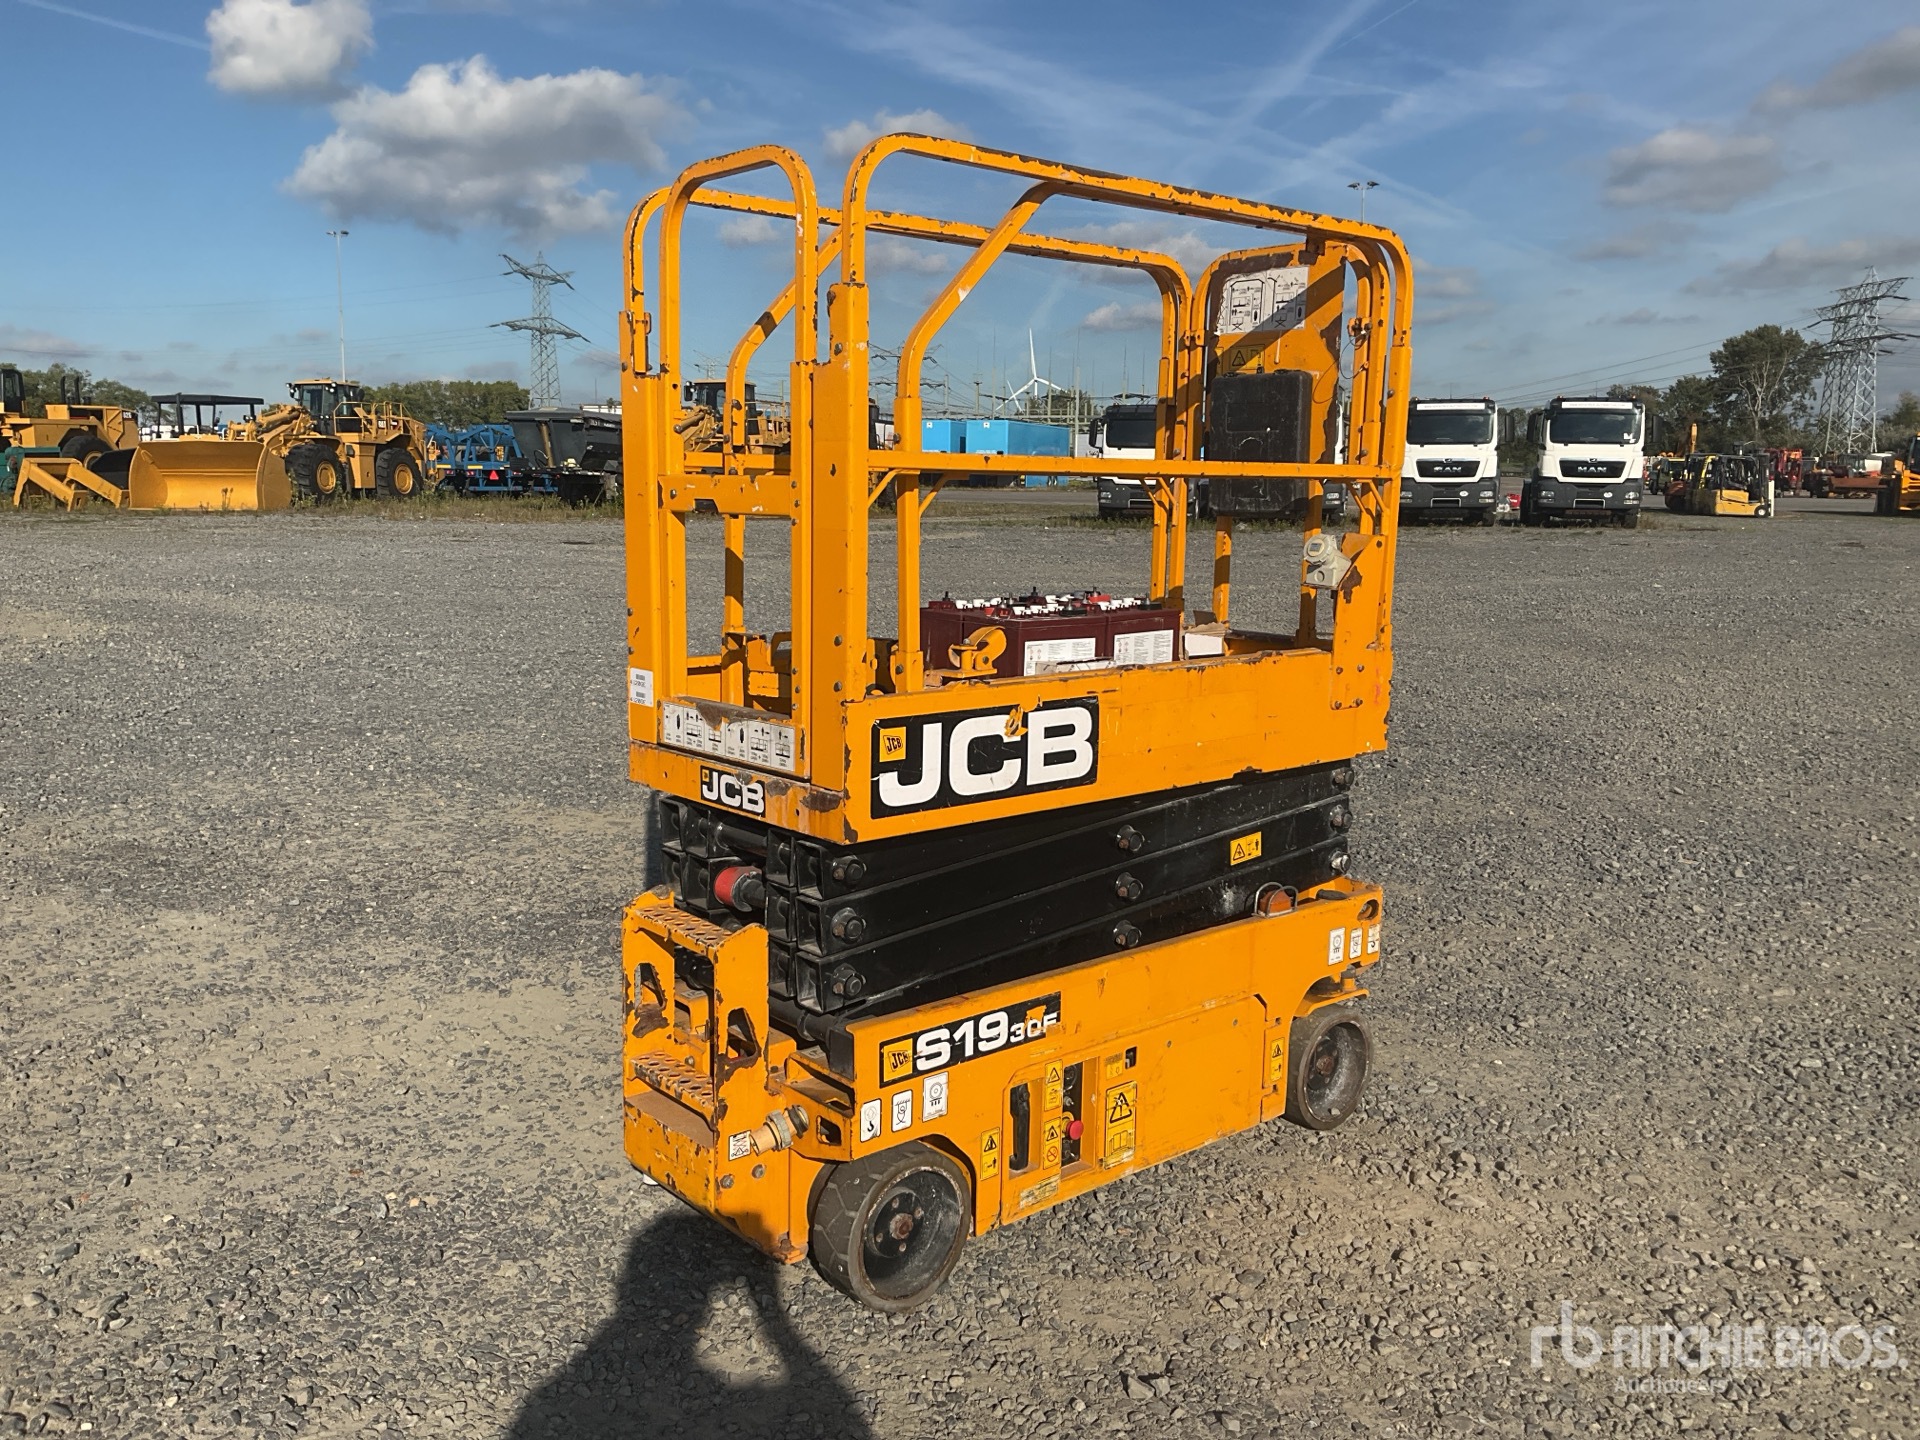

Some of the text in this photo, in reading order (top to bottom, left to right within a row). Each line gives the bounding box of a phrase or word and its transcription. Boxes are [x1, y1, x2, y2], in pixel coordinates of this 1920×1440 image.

[879, 706, 1093, 807] JCB
[886, 735, 902, 751] JCB
[702, 771, 765, 813] JCB
